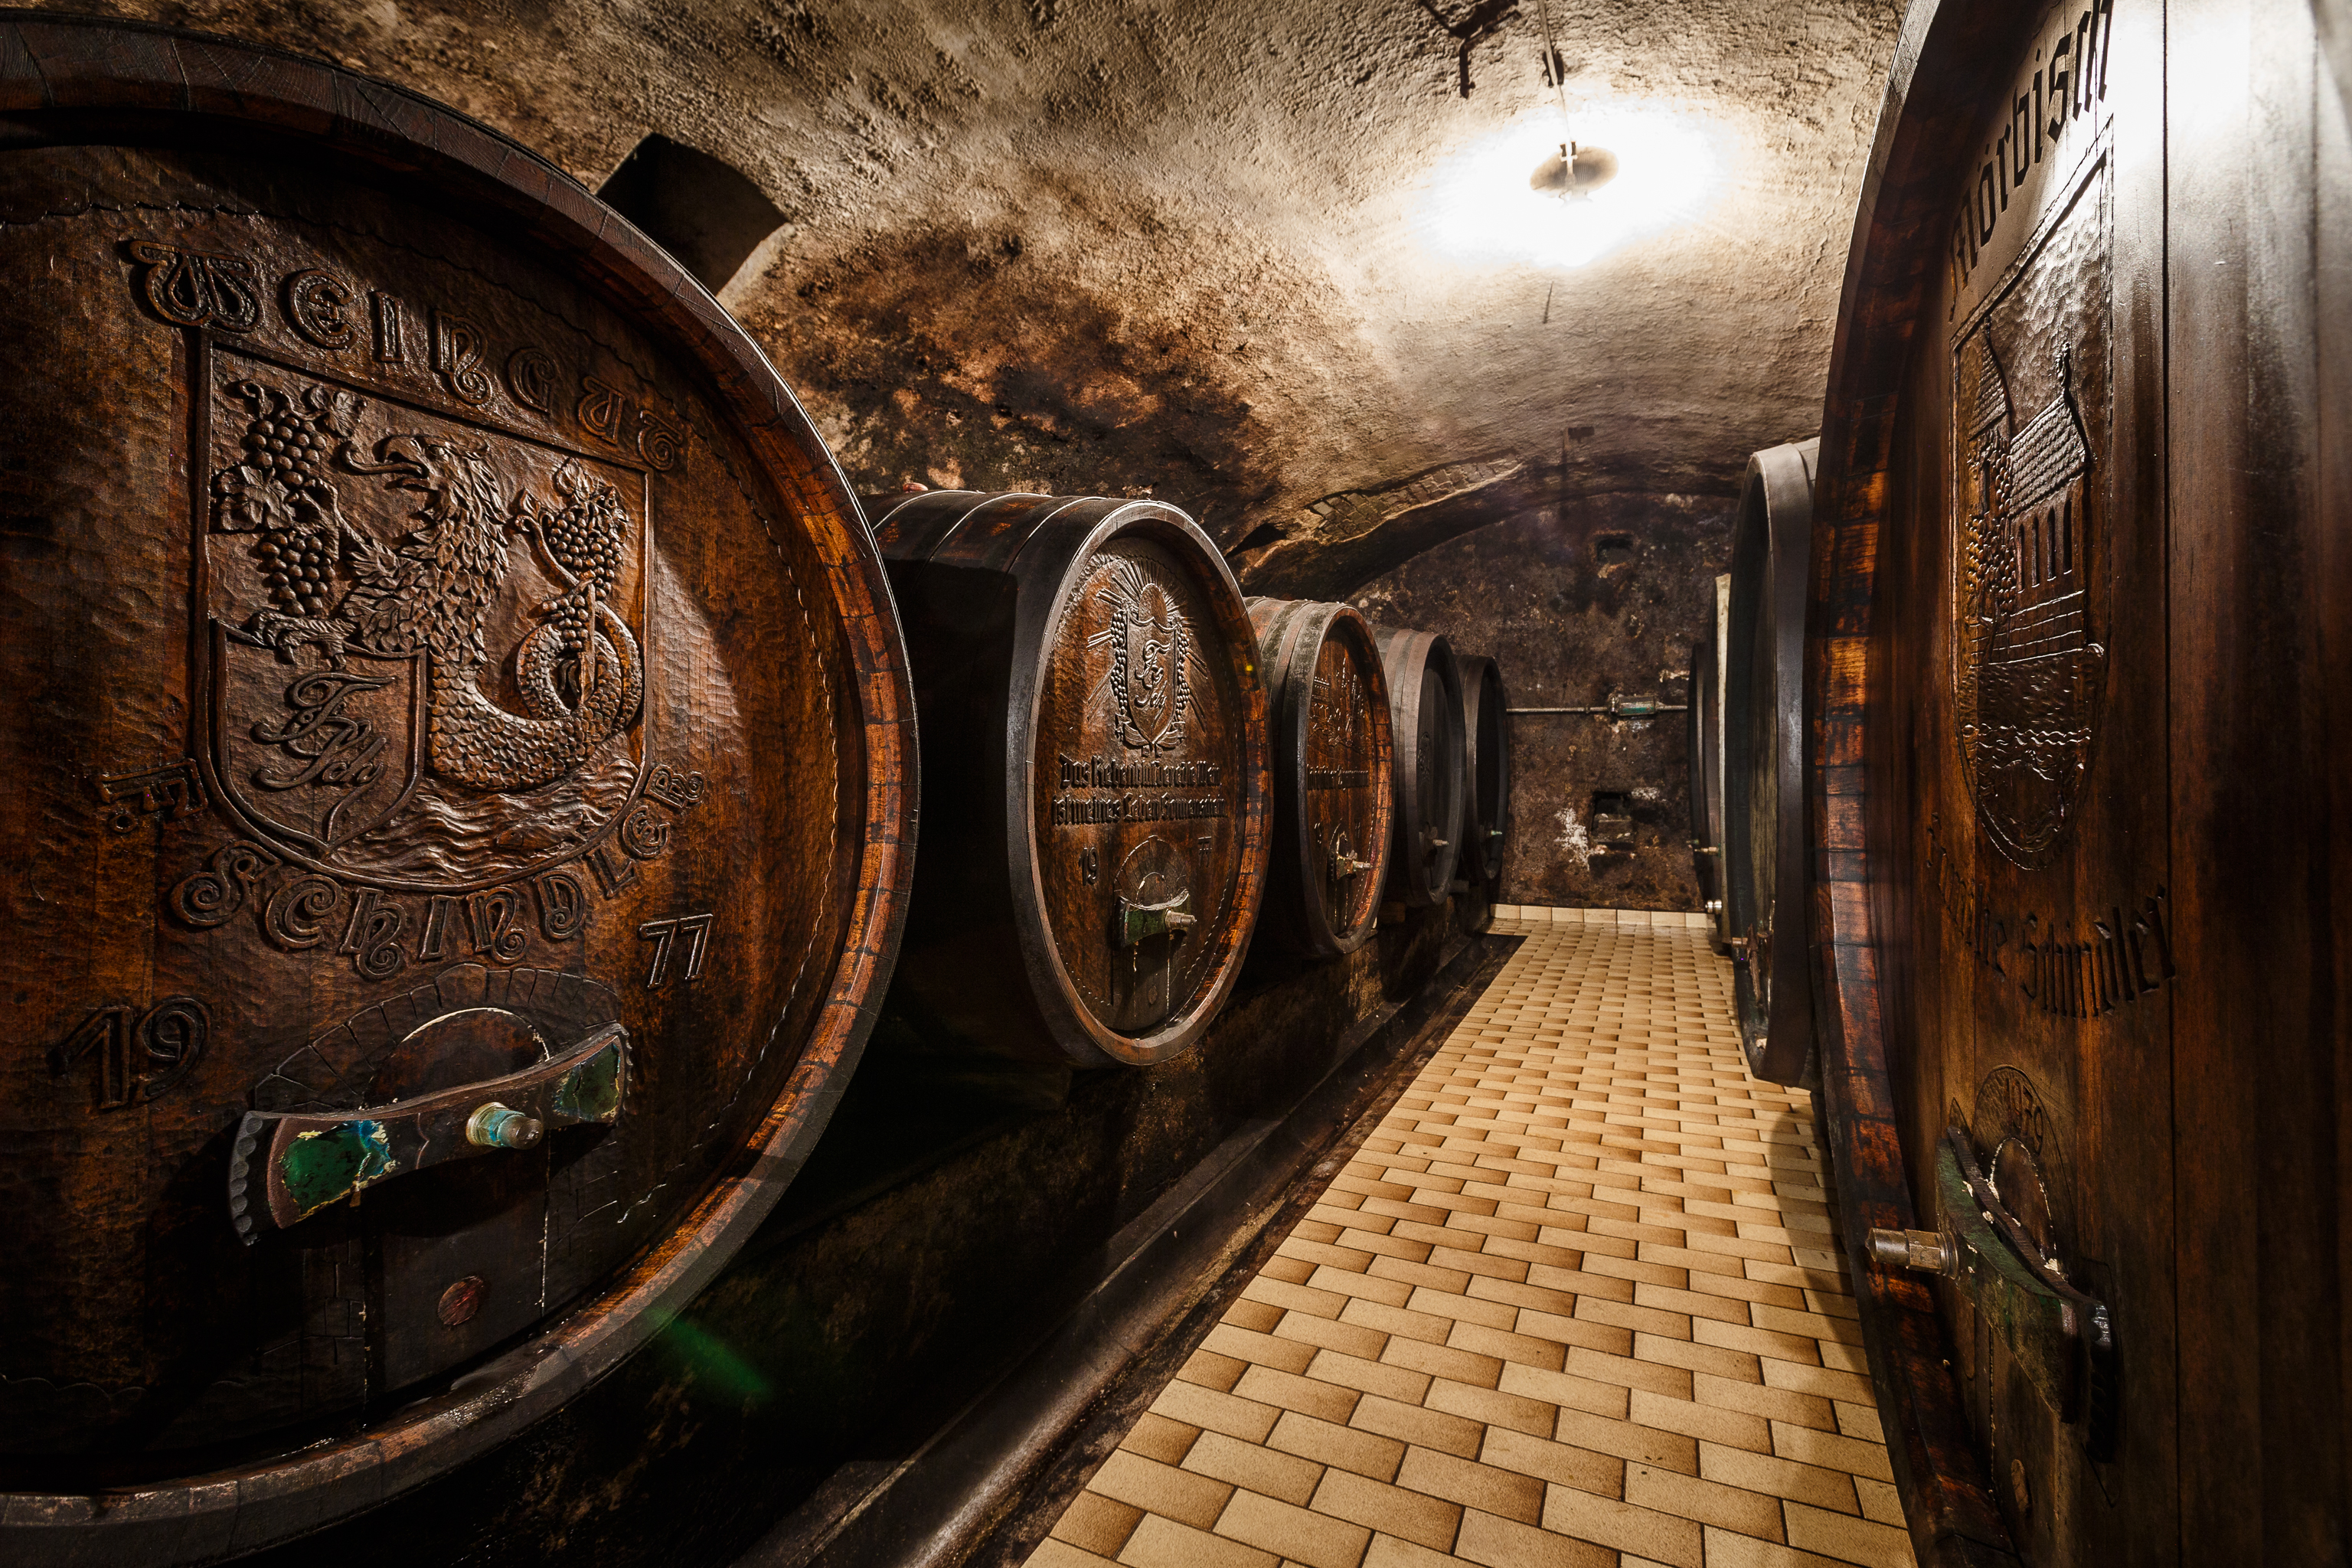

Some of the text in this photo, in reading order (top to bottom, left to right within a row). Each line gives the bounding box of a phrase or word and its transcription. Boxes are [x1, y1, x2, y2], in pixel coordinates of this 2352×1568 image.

[1059, 753, 1090, 789] Das
[1079, 847, 1099, 886] 19
[54, 912, 715, 1112] 19 77
